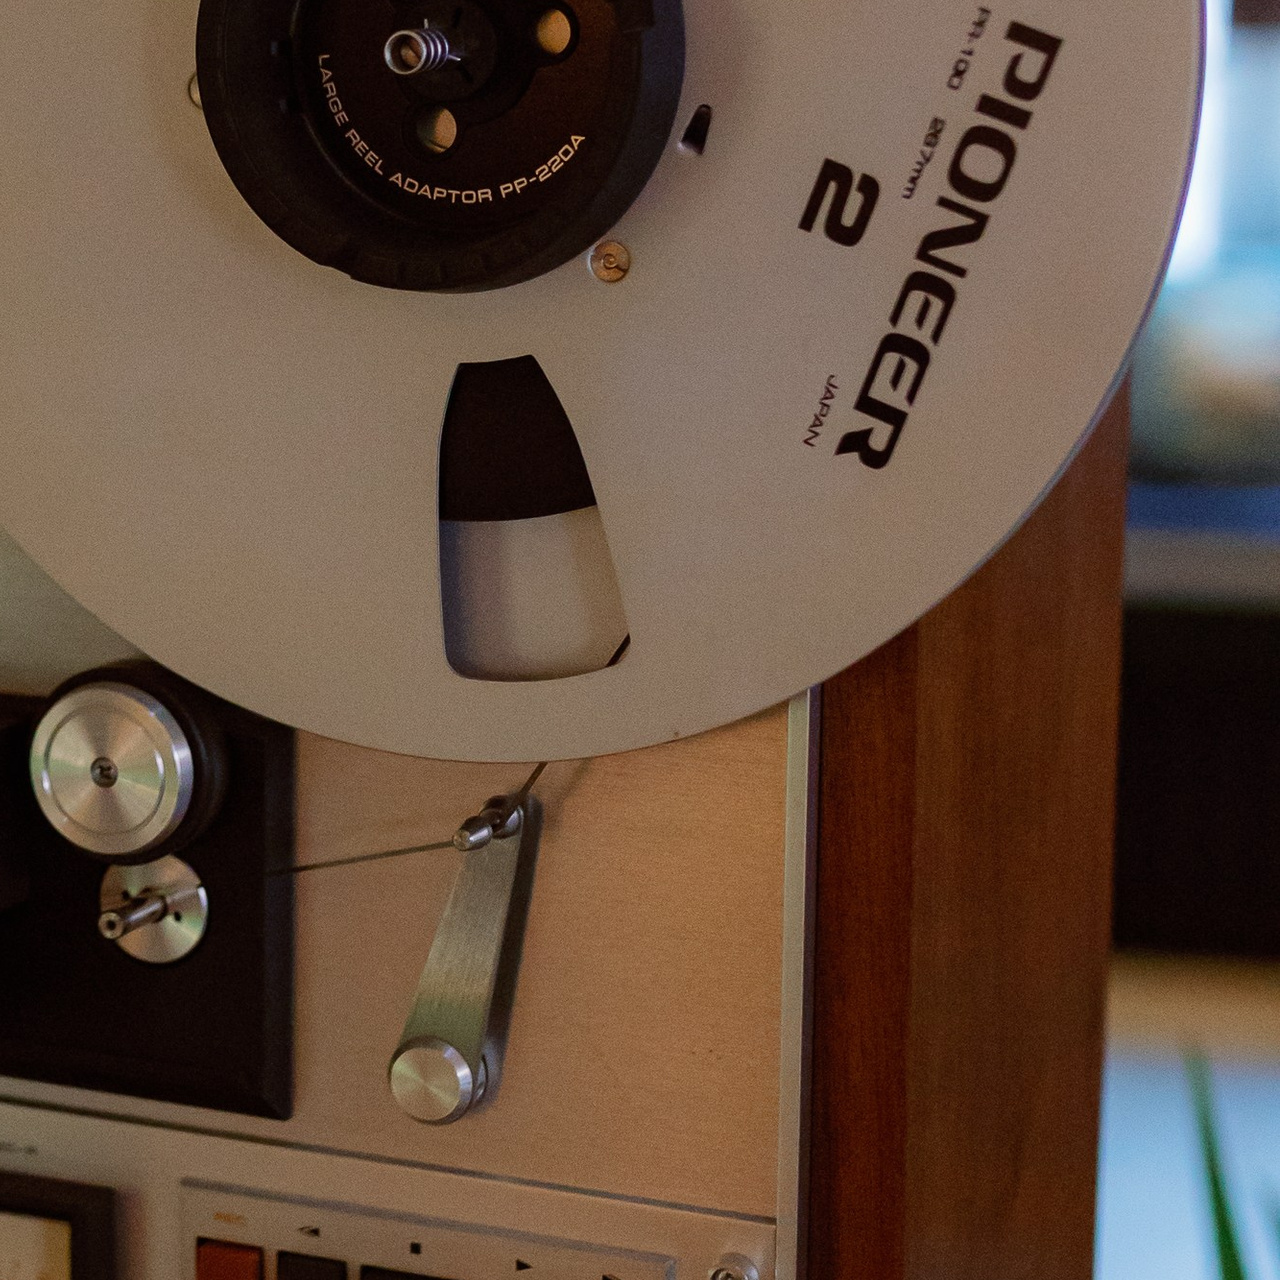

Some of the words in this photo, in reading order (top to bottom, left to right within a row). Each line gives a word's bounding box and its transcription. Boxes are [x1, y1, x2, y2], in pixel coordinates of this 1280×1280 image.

[947, 6, 991, 90] PR-100
[317, 53, 349, 128] LARGE
[344, 128, 384, 175] REEL
[389, 171, 493, 204] ADAPTOR
[500, 134, 586, 199] PP-220A
[798, 158, 880, 247] 2
[835, 21, 1064, 469] PIONEER
[803, 374, 839, 447] JAPAN
